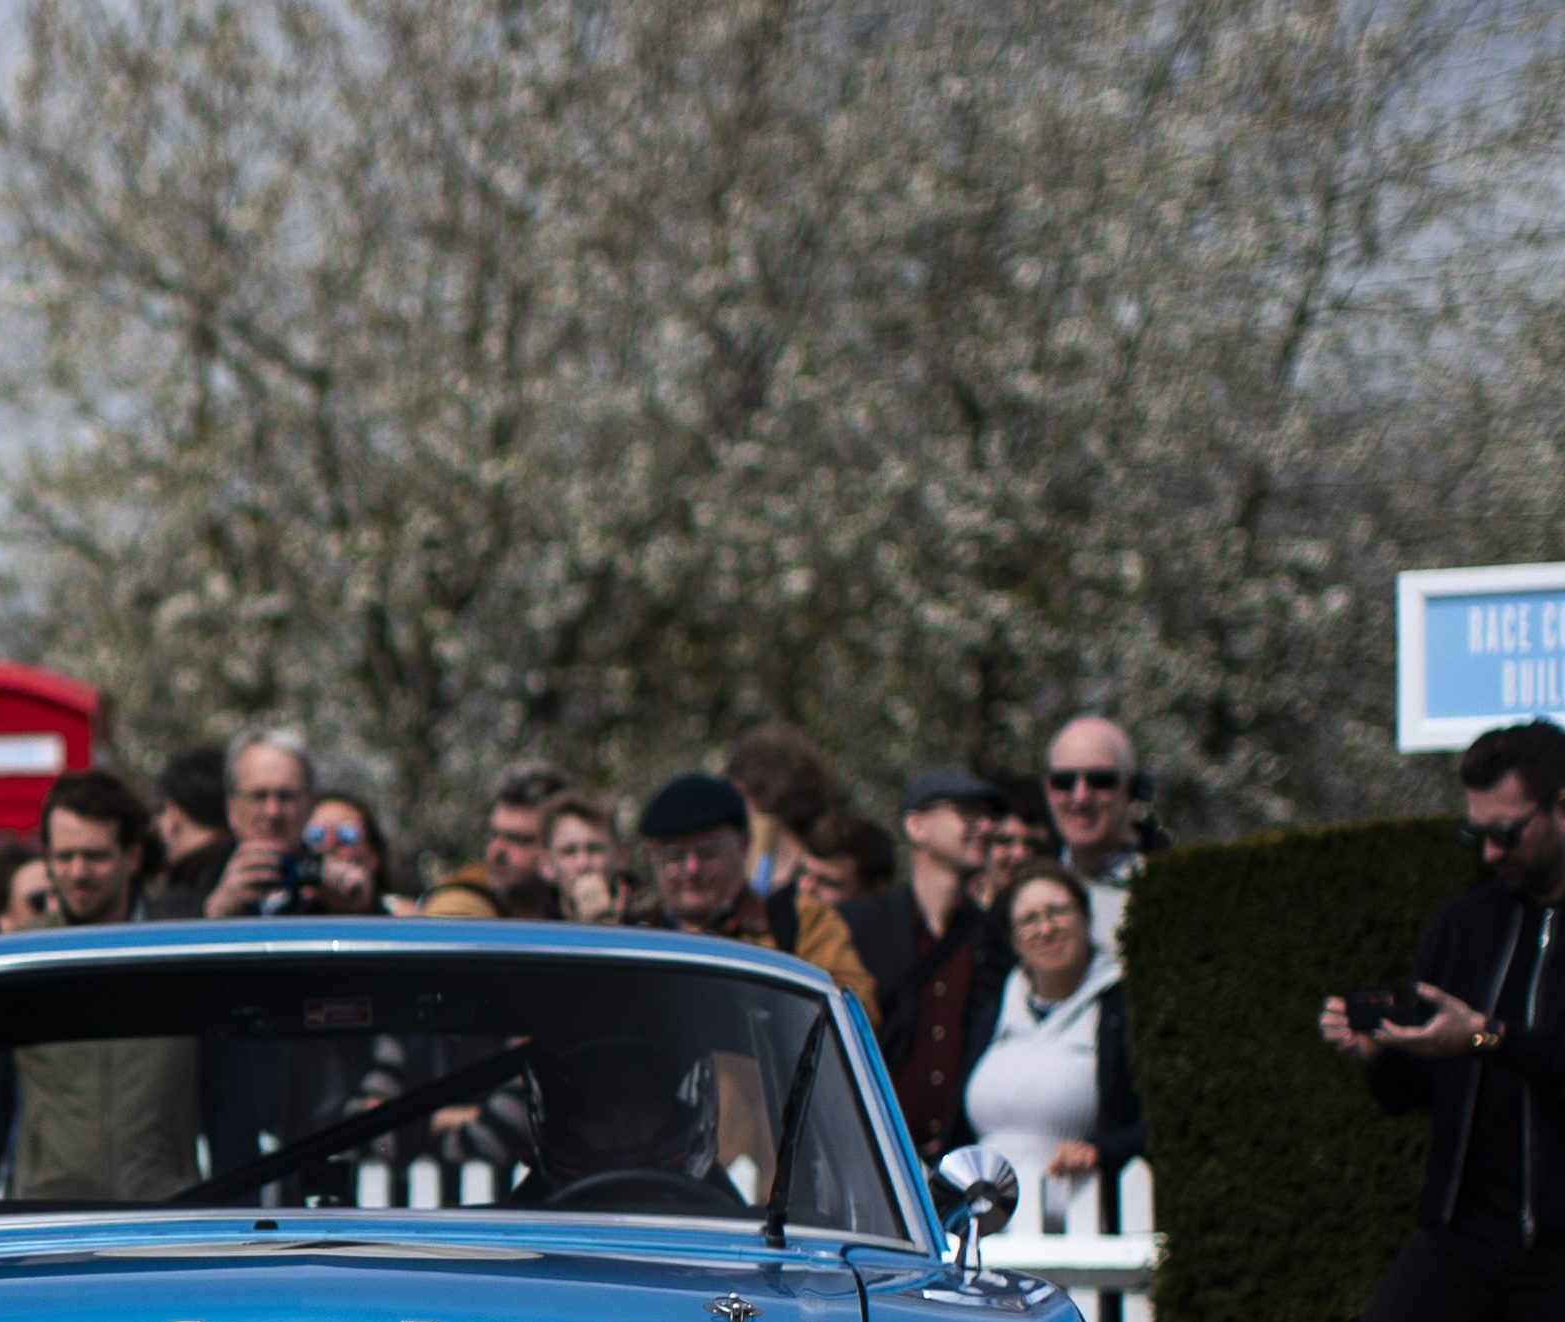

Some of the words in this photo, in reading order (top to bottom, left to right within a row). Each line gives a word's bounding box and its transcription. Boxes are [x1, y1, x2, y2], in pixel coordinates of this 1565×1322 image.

[1469, 602, 1533, 654] RACE
[1541, 600, 1565, 651] C
[1502, 657, 1565, 709] BUIL
